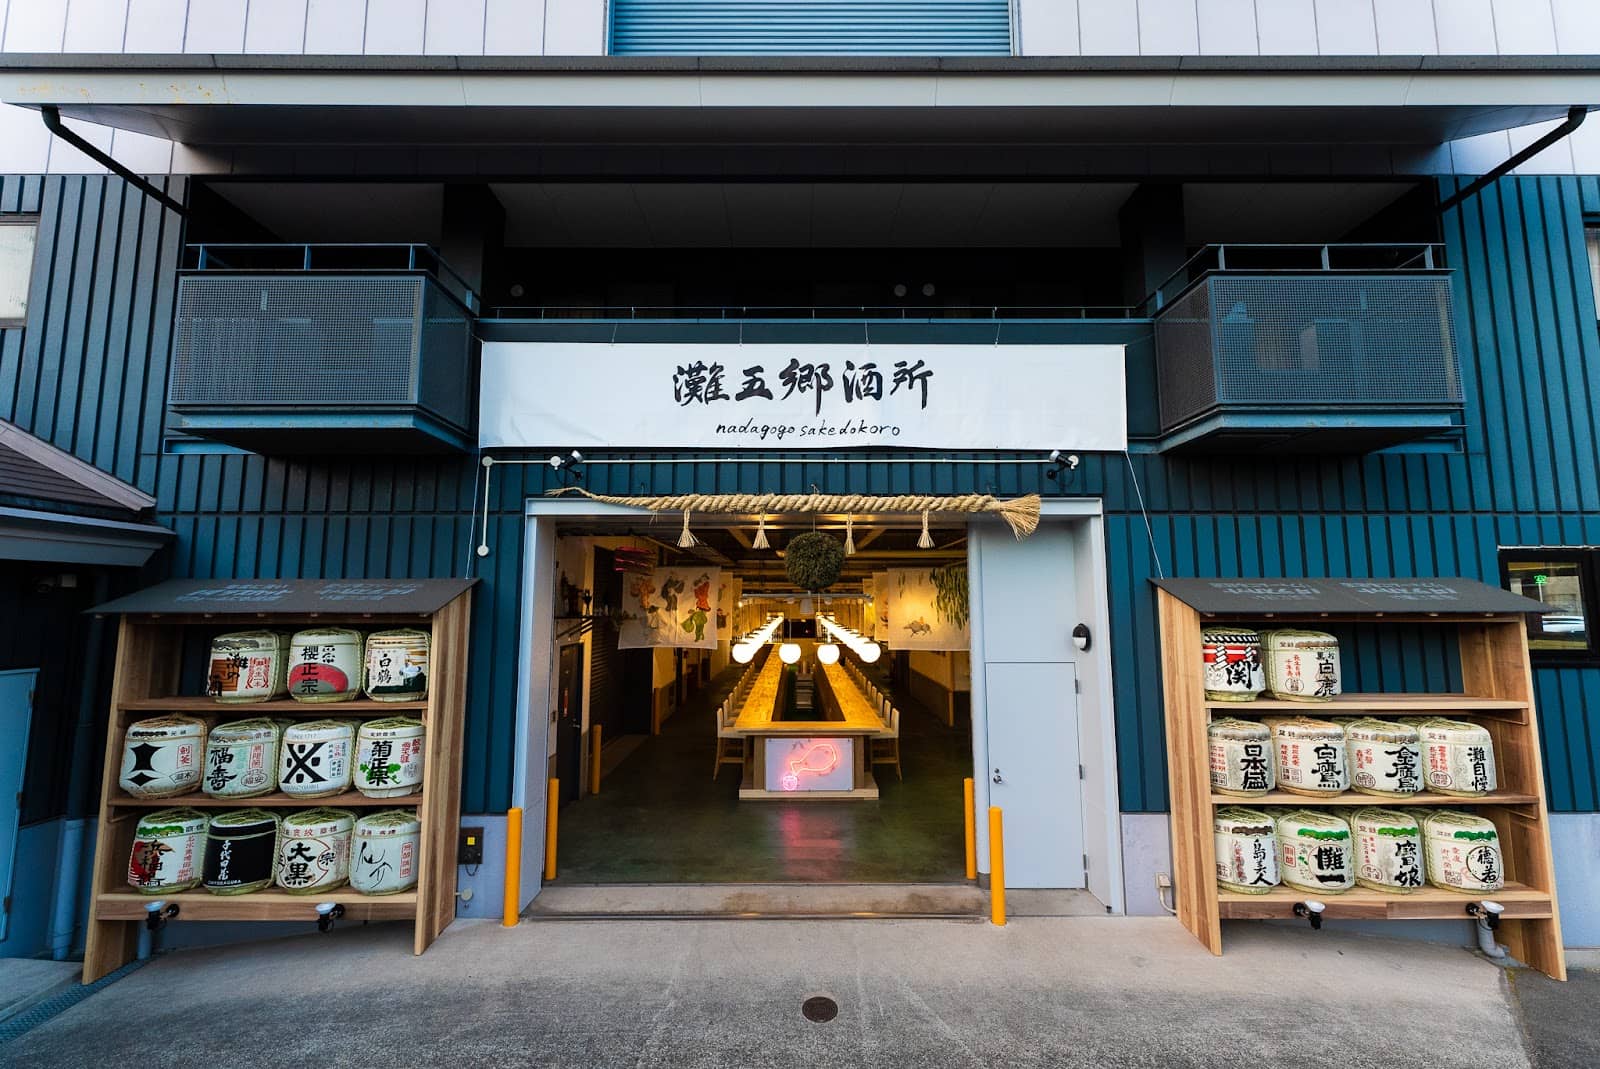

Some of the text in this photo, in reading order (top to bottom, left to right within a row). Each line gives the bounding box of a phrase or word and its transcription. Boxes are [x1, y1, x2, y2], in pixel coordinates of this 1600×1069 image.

[673, 358, 934, 416] 灘五郷酒所
[716, 418, 795, 440] nadagogo
[368, 740, 393, 787] 菊正宗
[1240, 744, 1268, 790] 日本盛
[1311, 743, 1342, 789] 白鷹
[1467, 747, 1489, 792] 灘自慢
[1249, 838, 1274, 886] 島美人
